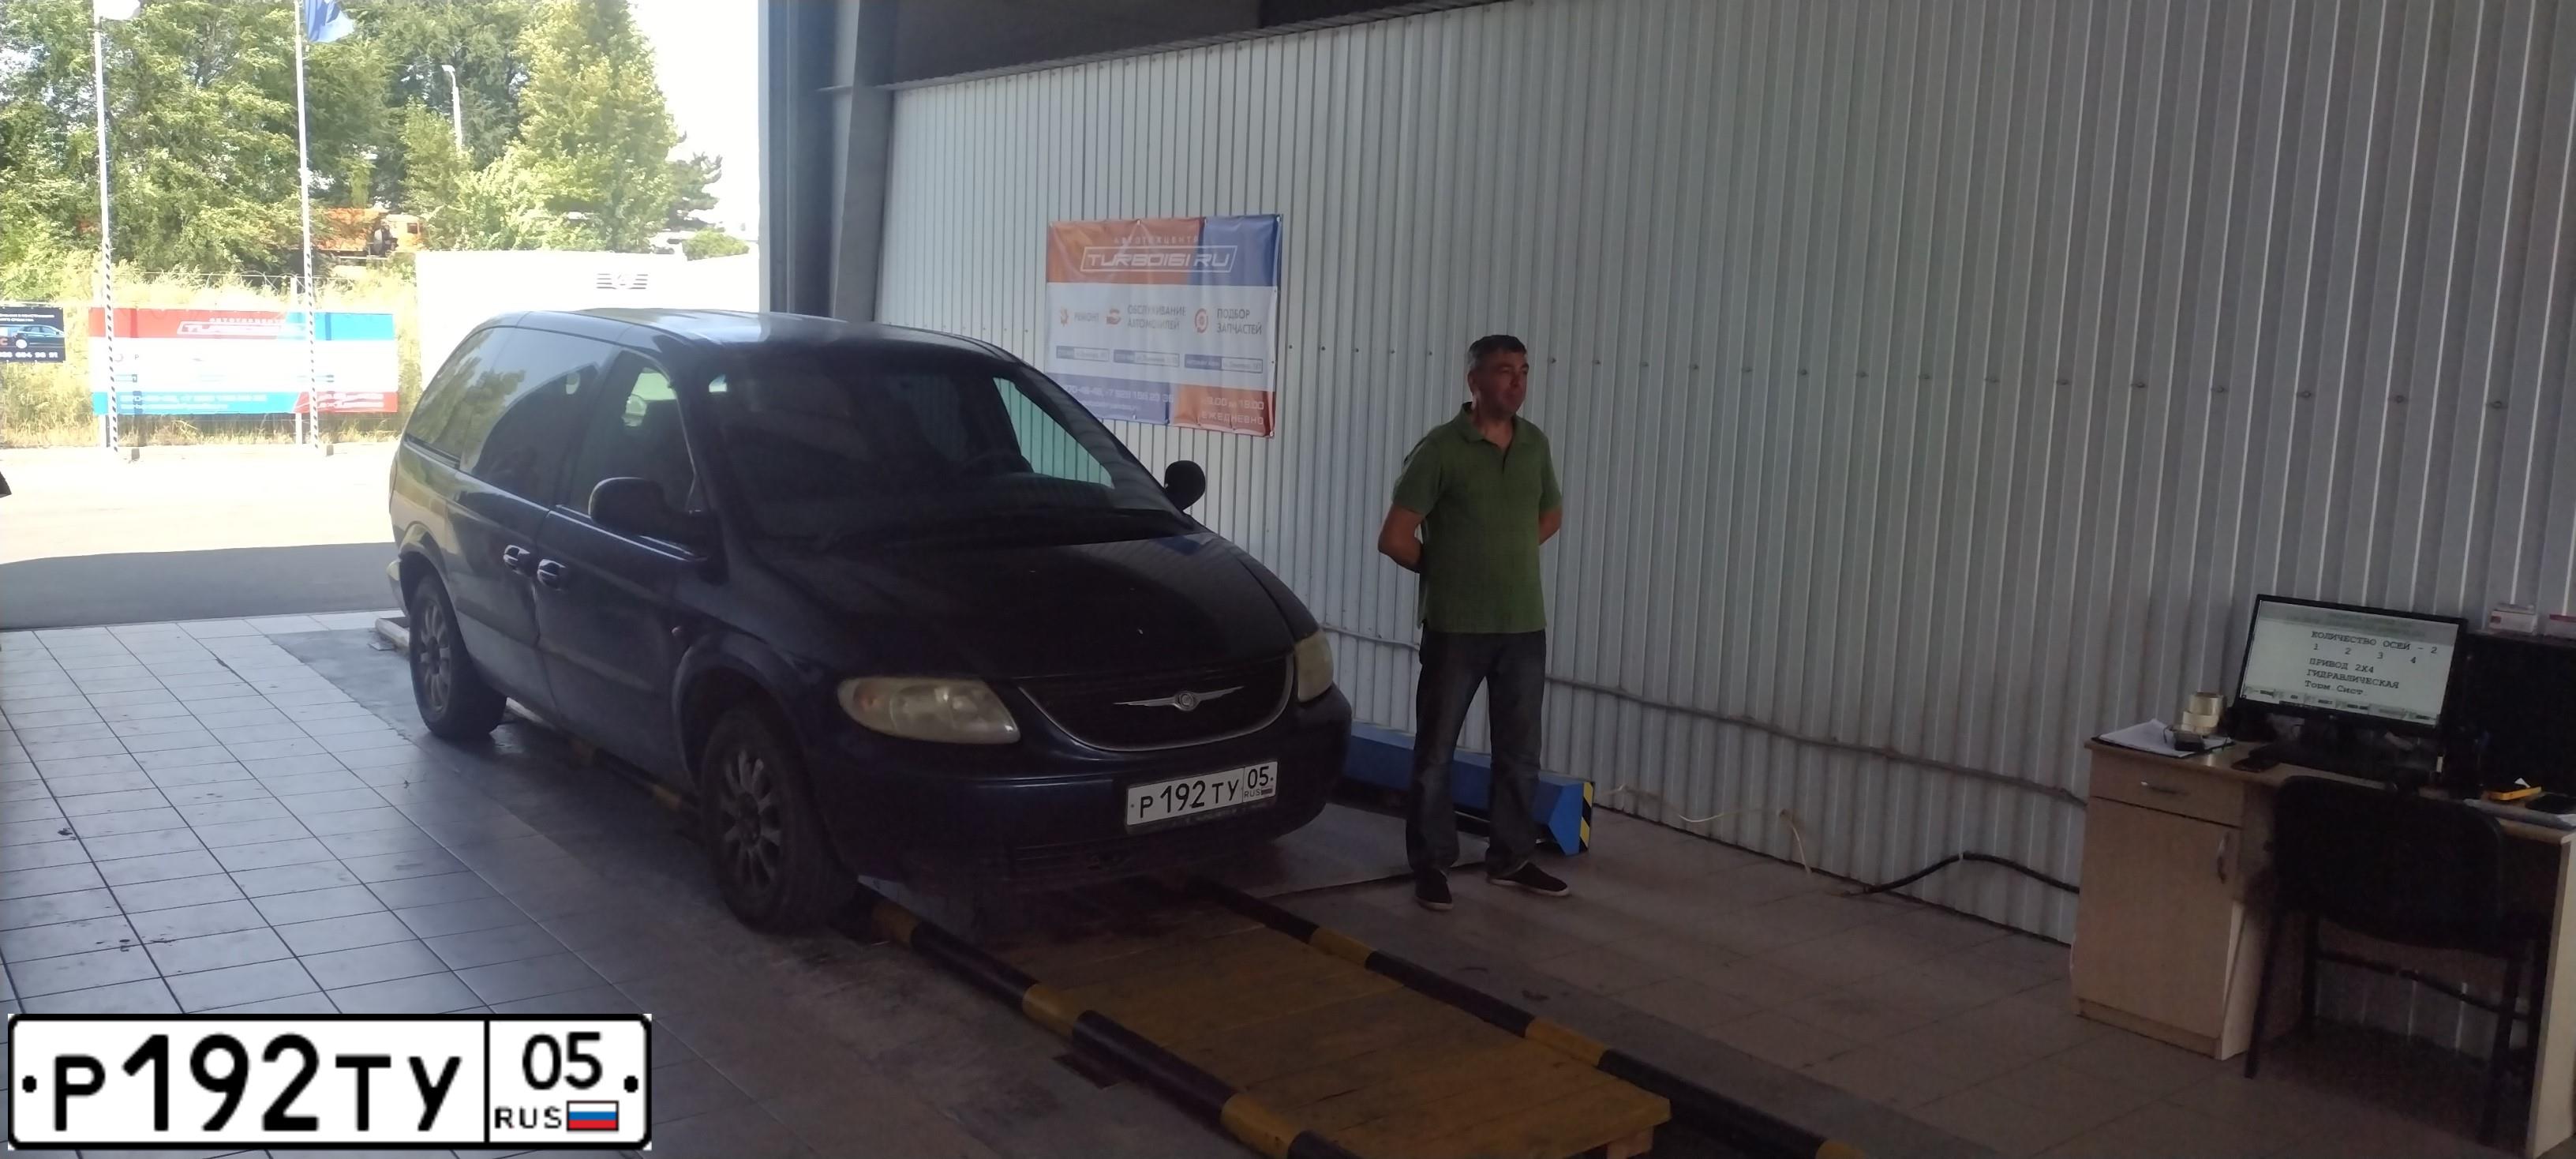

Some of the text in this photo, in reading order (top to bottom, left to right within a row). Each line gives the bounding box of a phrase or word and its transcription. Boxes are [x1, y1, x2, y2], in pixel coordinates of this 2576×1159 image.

[1127, 304, 1187, 317] ОБСЛУЖИВАНИЕ
[1216, 308, 1251, 321] ПОДБОР
[1216, 320, 1263, 336] ЗАПЧАСТЕЙ
[1201, 410, 1264, 426] ЕЖЕДНЕВНО
[2310, 630, 2376, 646] КОЛИЧЕСТВО
[2383, 640, 2410, 651] ОСЕЙ
[2430, 646, 2438, 655] 2
[2313, 643, 2417, 664] 1 2 3 4
[2308, 657, 2349, 671] ПРИВОД
[2306, 668, 2400, 689] ГИДРАВЛИЧЕСКАЯ
[1247, 765, 1270, 790] 05
[1244, 789, 1261, 798] RUS
